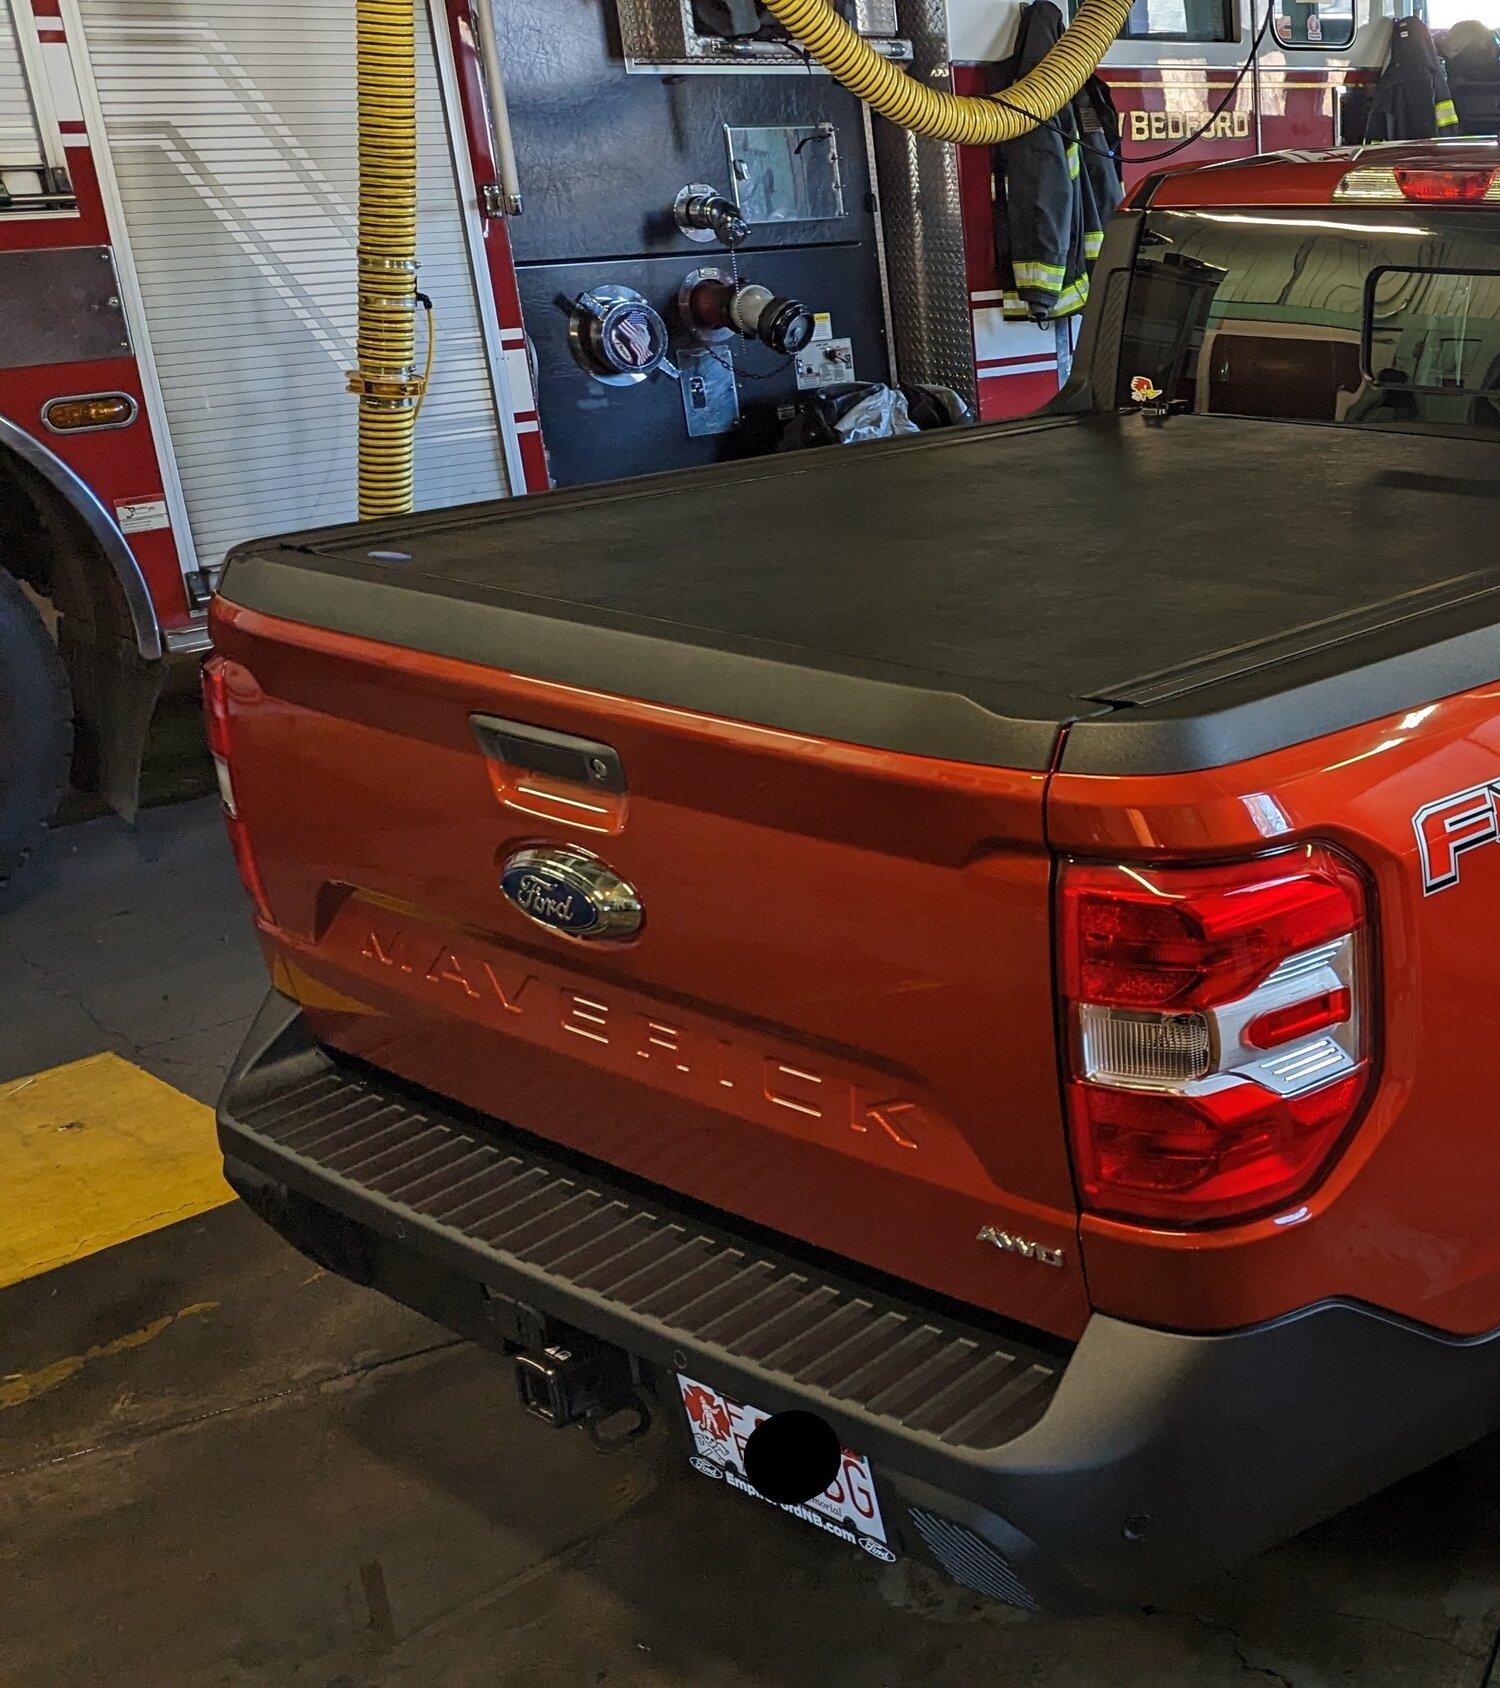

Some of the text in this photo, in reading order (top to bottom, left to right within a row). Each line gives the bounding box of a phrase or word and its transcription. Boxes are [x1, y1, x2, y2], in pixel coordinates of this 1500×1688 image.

[1130, 111, 1250, 141] BEDFORD
[517, 874, 574, 921] Ford
[360, 929, 918, 1149] MAVERICK
[976, 1225, 1064, 1267] AWD
[692, 1458, 719, 1477] Ford
[862, 1539, 890, 1560] Ford
